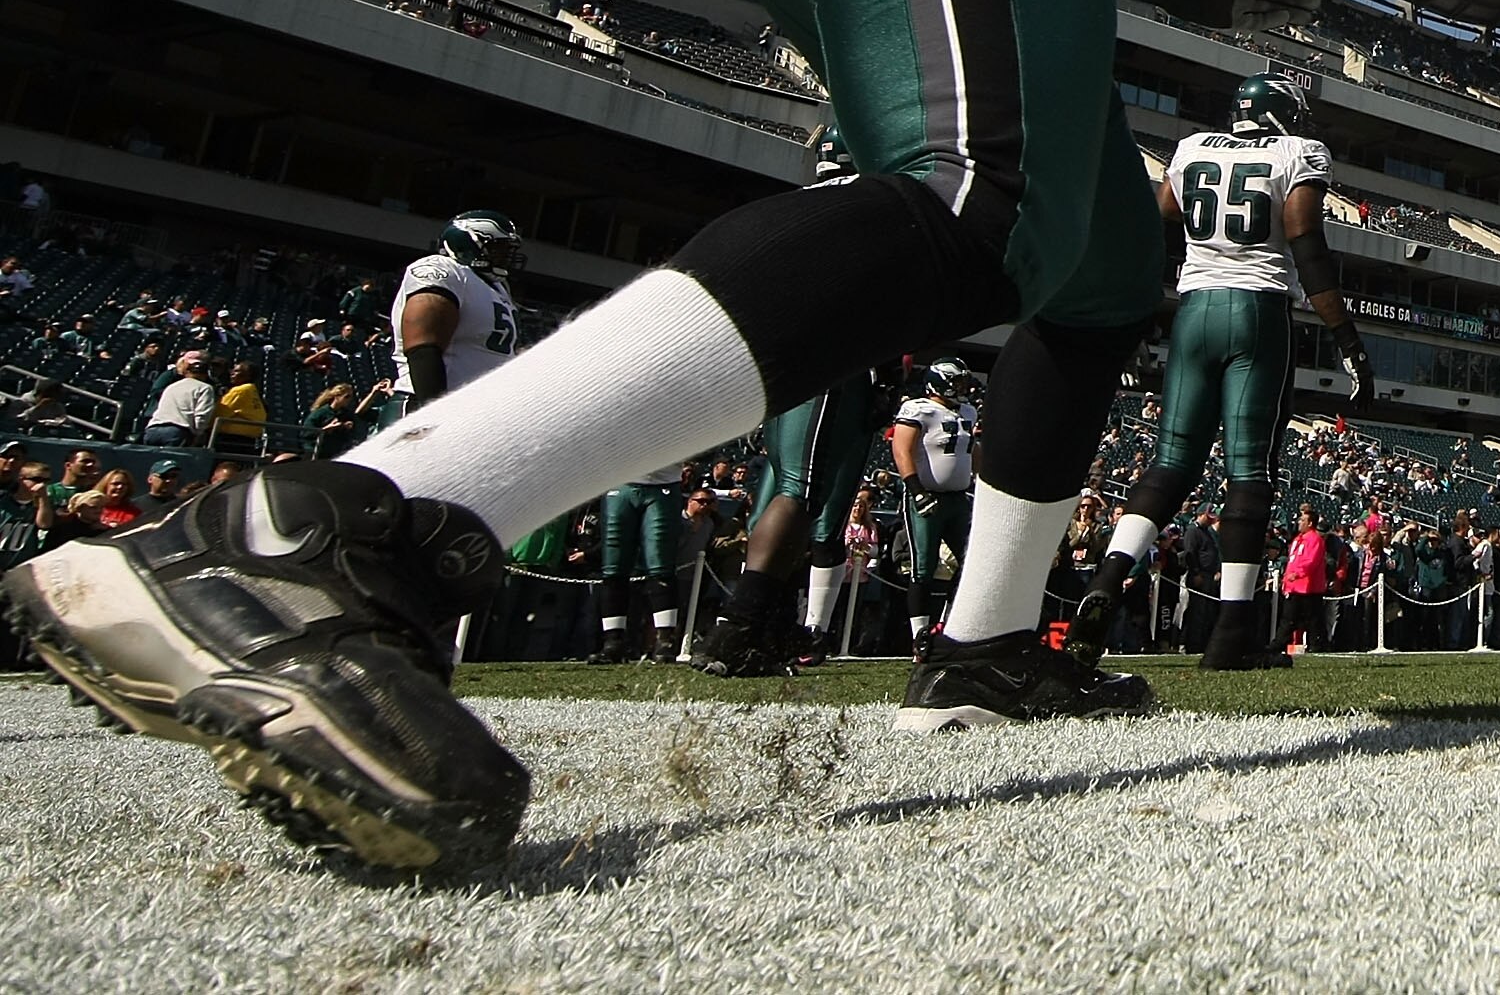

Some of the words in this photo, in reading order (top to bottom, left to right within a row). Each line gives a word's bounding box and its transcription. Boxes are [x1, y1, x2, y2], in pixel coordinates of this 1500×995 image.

[1182, 161, 1273, 245] 65
[486, 301, 519, 355] 5
[1360, 300, 1396, 320] EAGLES
